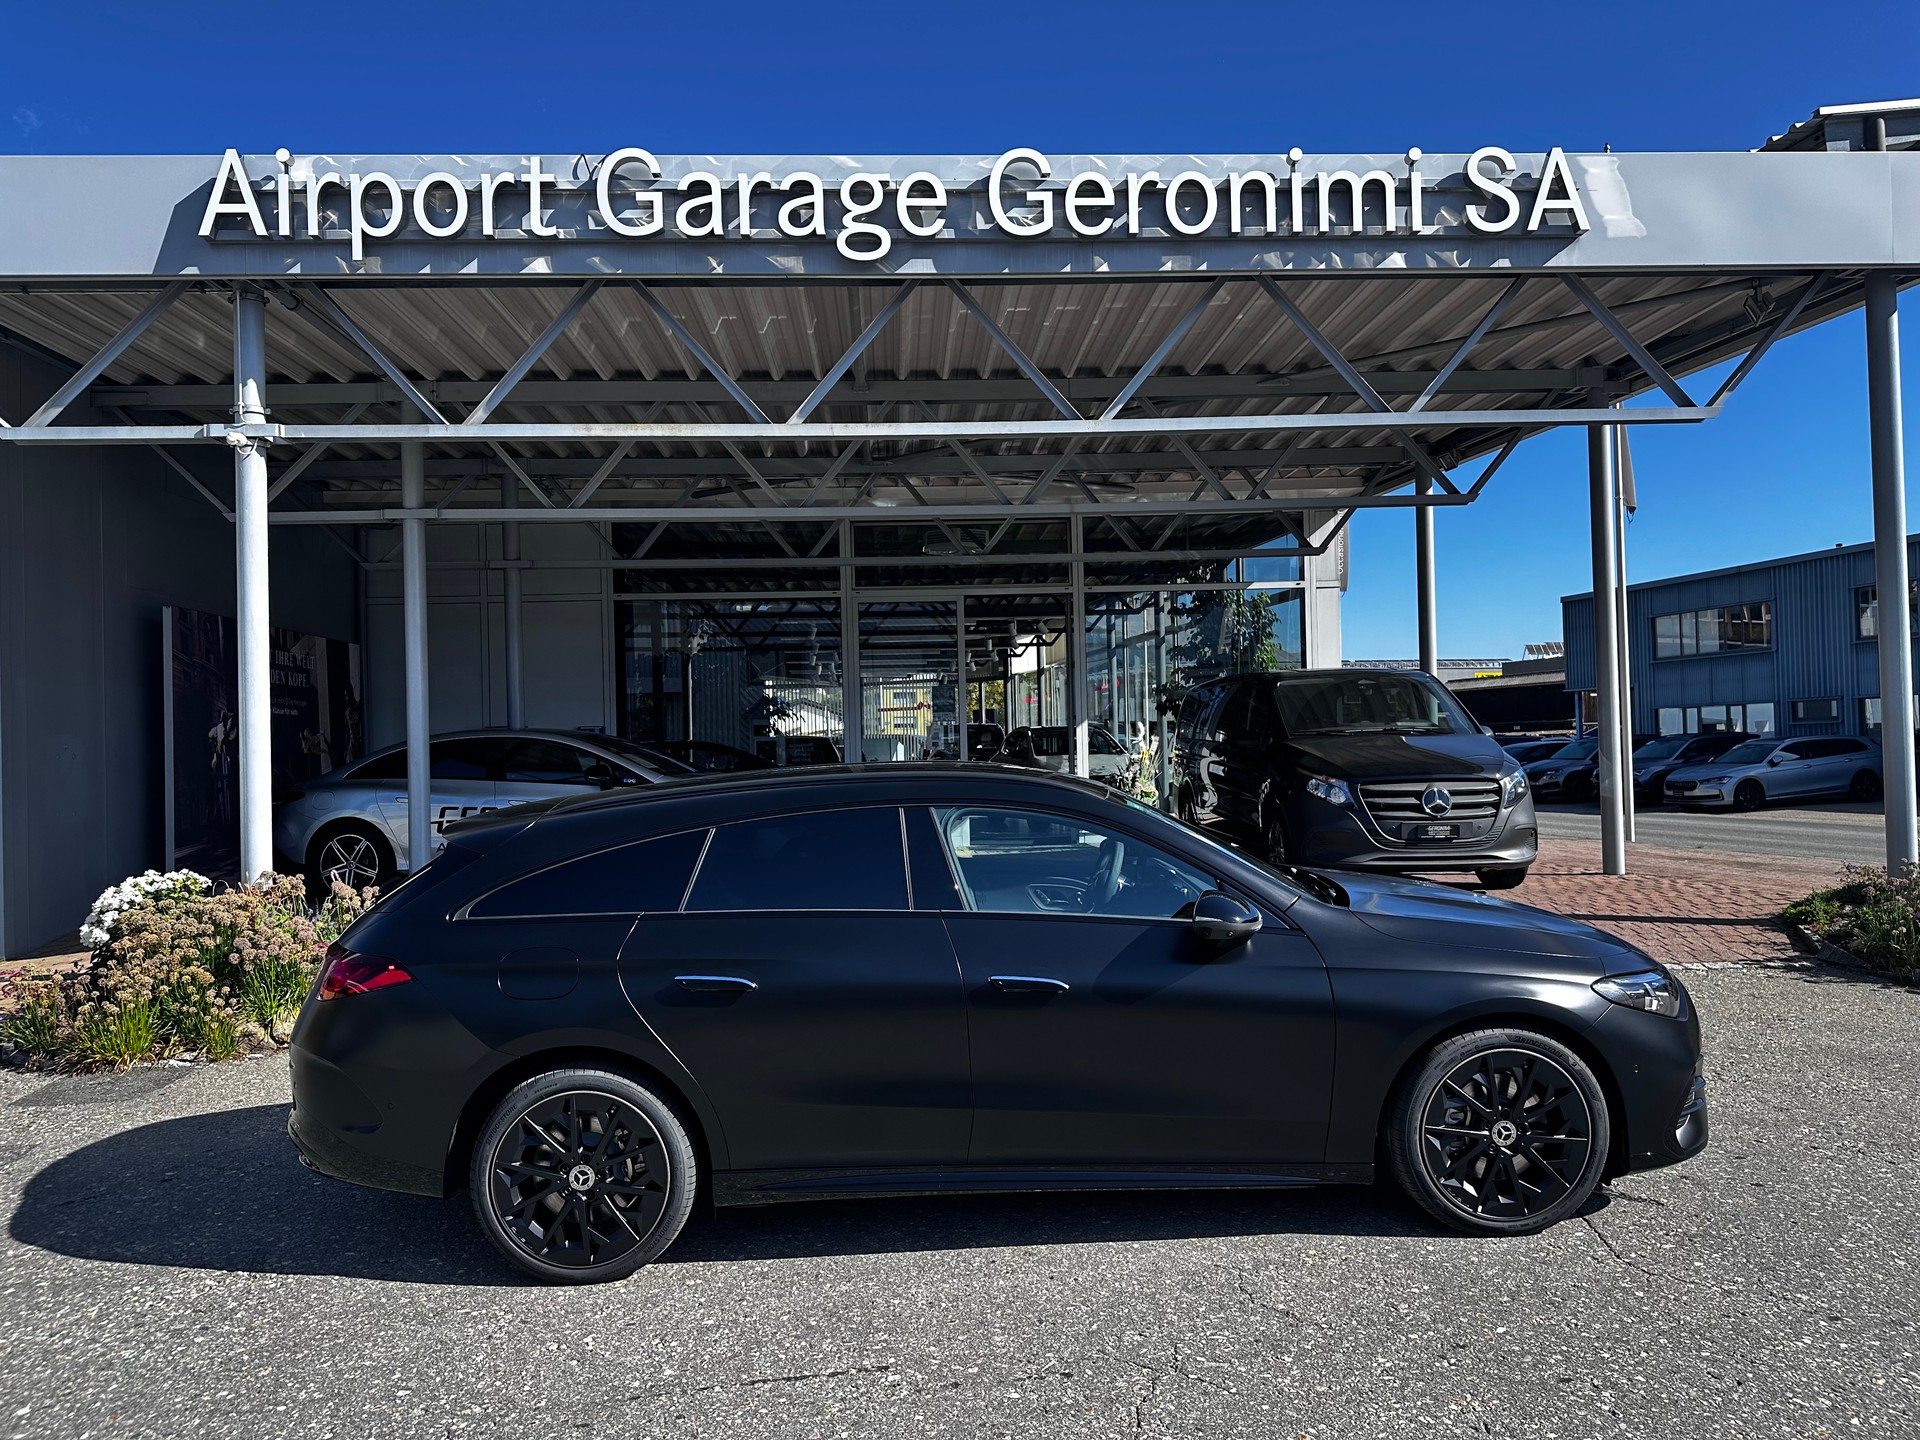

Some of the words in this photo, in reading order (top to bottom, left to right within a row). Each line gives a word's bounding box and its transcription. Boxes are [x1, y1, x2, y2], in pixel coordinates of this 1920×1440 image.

[198, 148, 557, 260] Airport
[596, 147, 948, 261] Garage
[988, 148, 1424, 236] Geronimi
[1463, 147, 1589, 234] SA
[275, 650, 294, 667] IHRE
[295, 653, 316, 670] WELT
[271, 668, 286, 685] DEN
[1514, 1035, 1565, 1060] BRIDGESTONE
[485, 1103, 518, 1146] BRIDGESTONE
